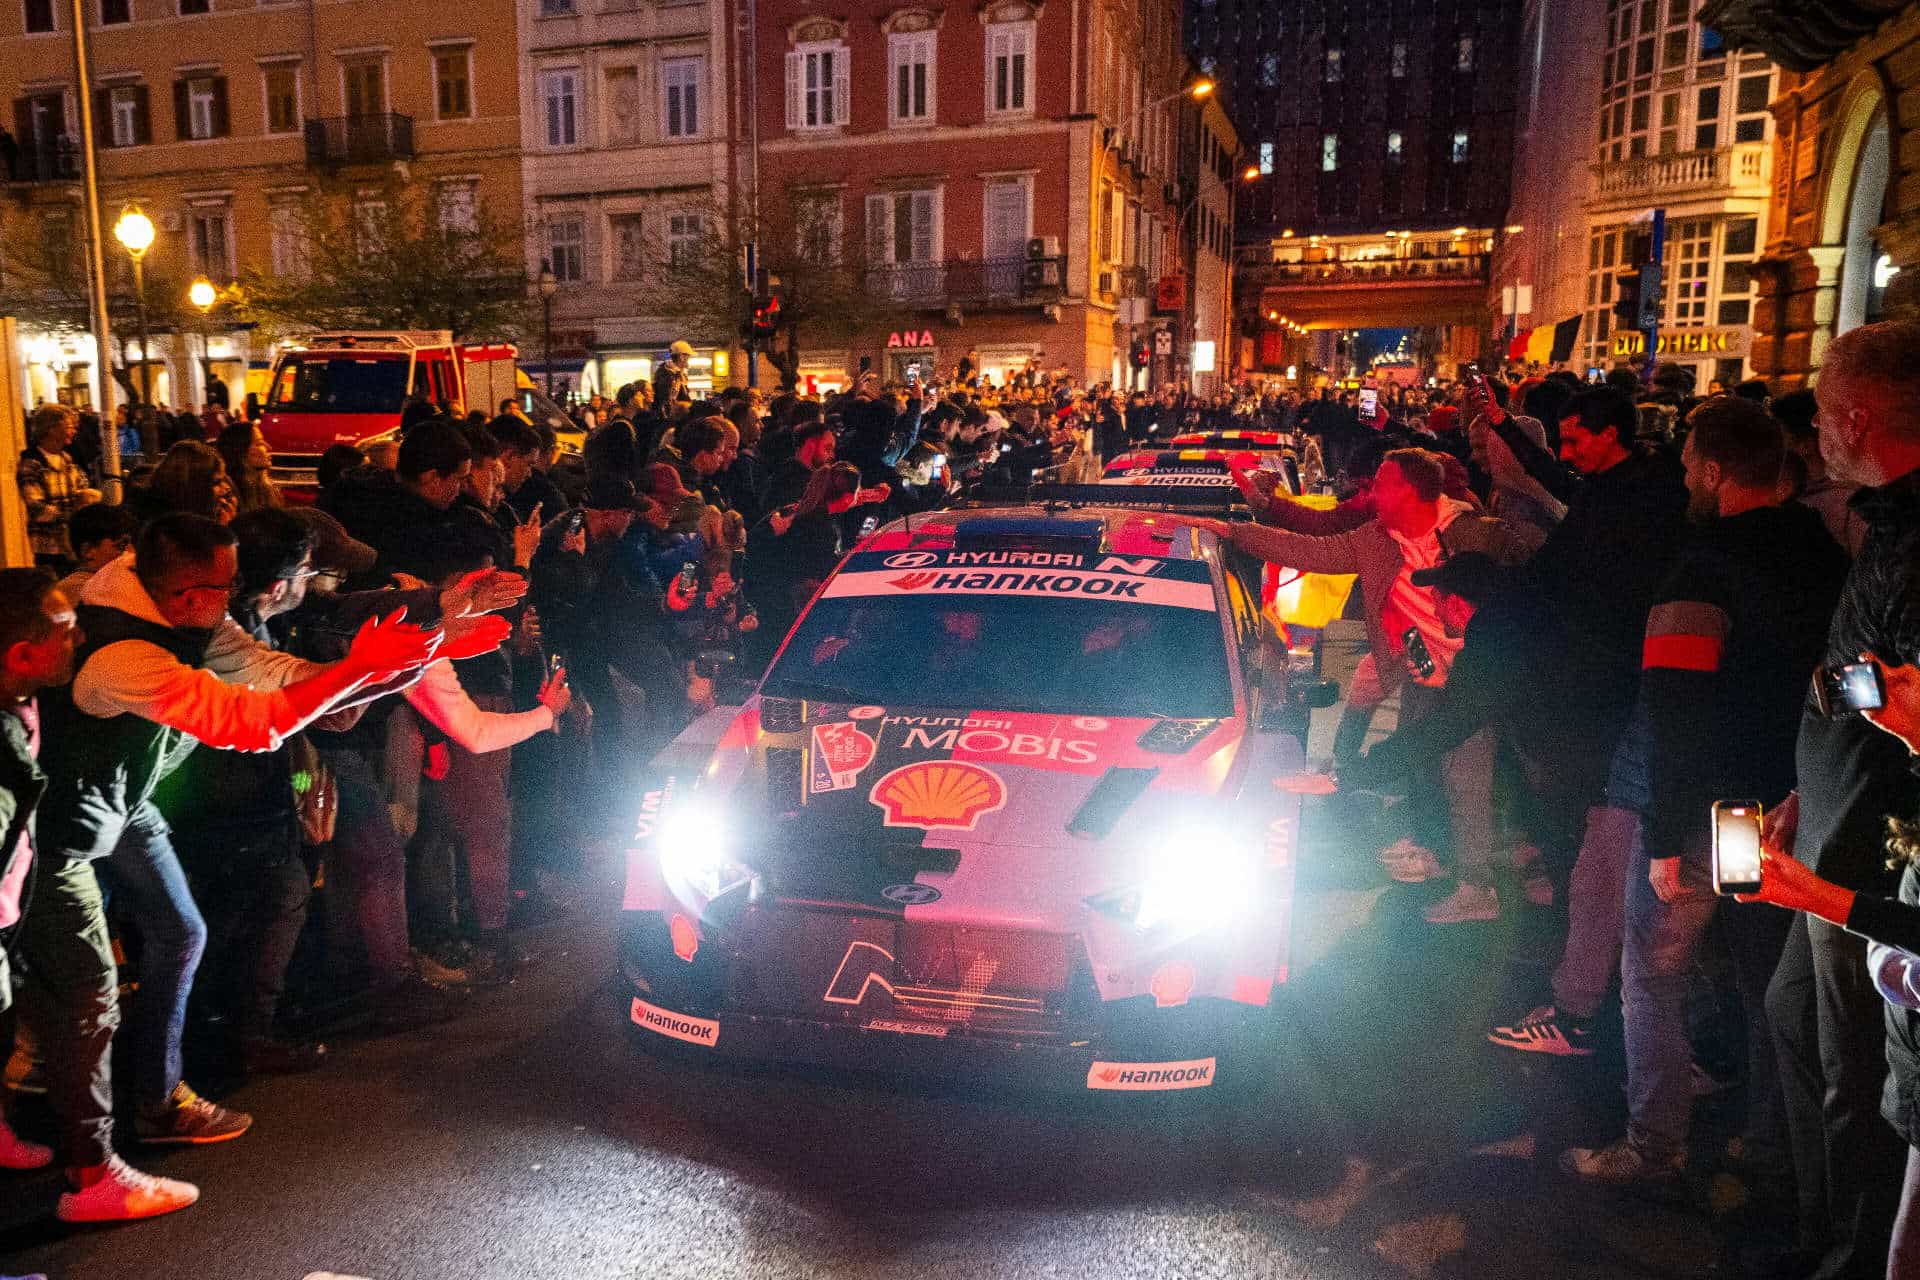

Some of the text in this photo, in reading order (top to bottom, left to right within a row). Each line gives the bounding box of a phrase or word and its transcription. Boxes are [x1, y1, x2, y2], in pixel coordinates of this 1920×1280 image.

[887, 329, 934, 347] ANA
[946, 551, 1166, 576] HYUNDAI N
[883, 716, 1012, 730] HYUNDAI
[901, 728, 1098, 764] MOBIS
